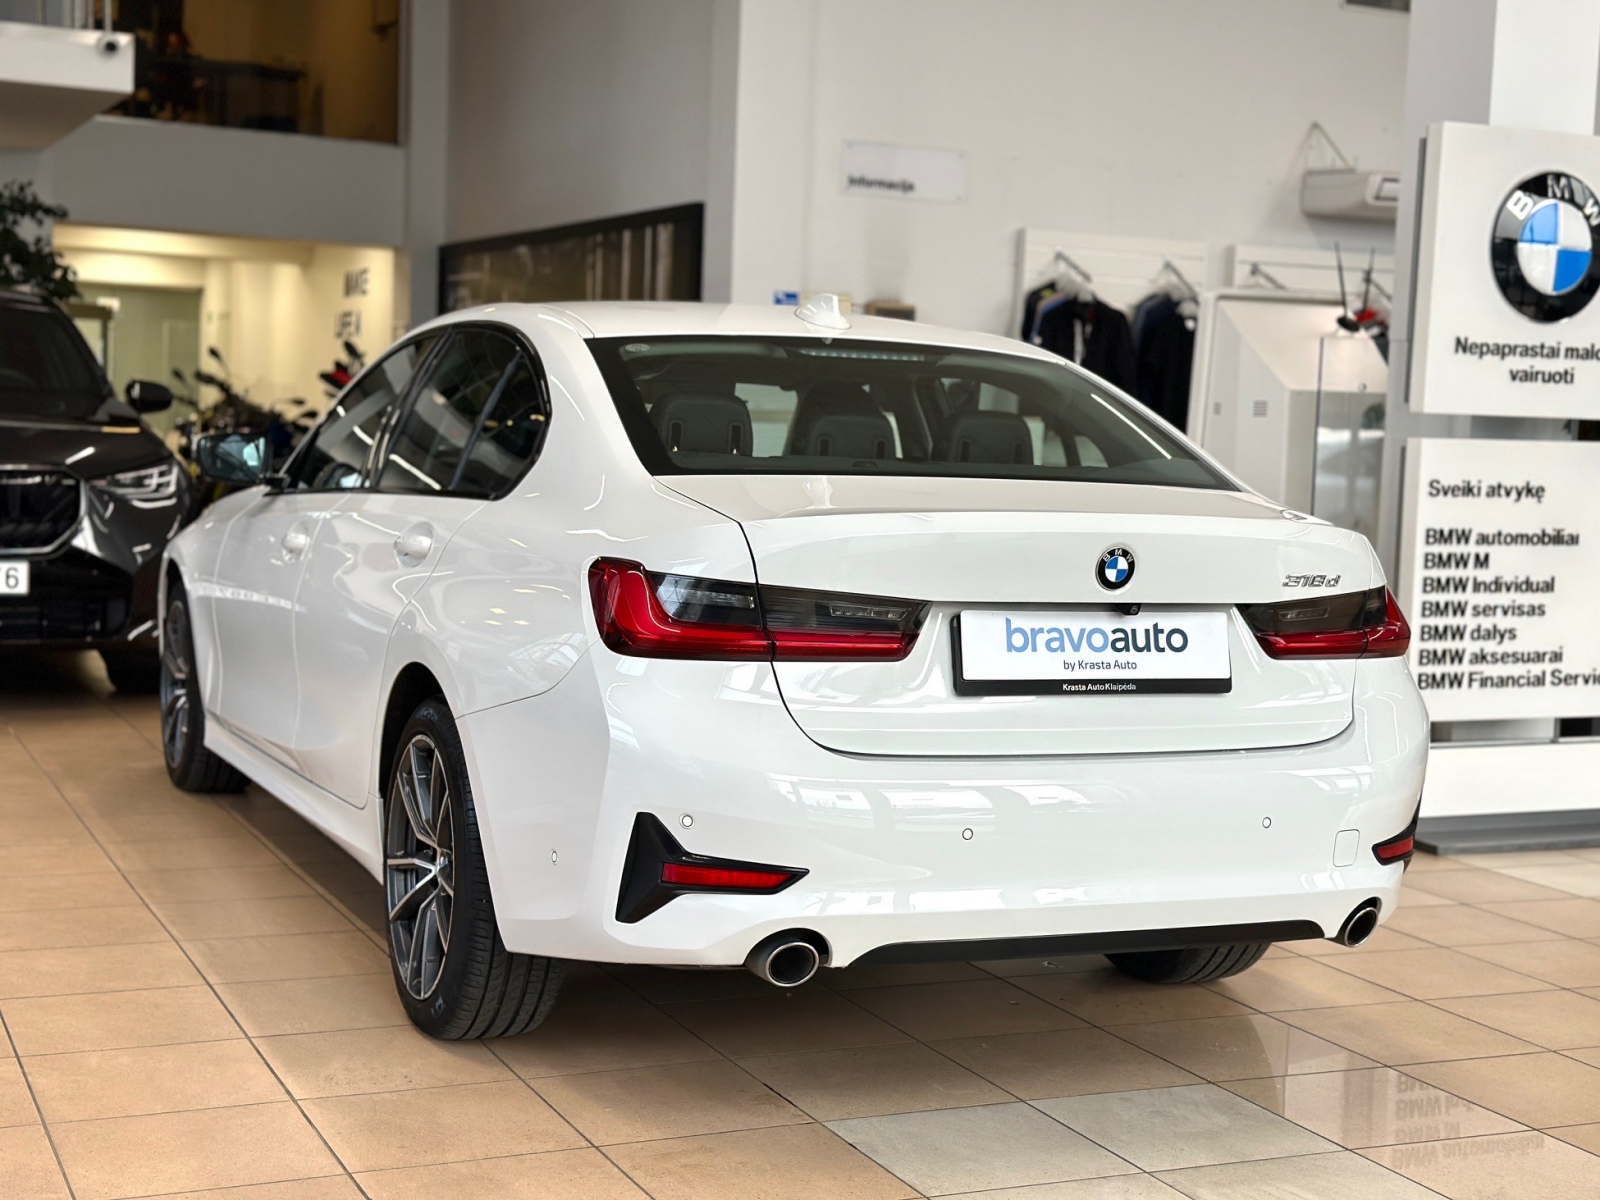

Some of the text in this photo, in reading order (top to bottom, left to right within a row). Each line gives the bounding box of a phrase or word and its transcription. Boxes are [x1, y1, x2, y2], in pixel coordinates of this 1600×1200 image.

[1454, 336, 1561, 361] Nepaprastai
[1509, 365, 1574, 384] vairuoti
[1428, 479, 1546, 504] Sveiki atvykę
[1425, 528, 1580, 546] BMW automobiliai
[1102, 548, 1134, 563] BMW
[1424, 552, 1489, 570] BMW M
[0, 566, 19, 590] 6
[1282, 574, 1340, 588] 318d
[1422, 576, 1555, 594] BMW Individual
[1421, 600, 1546, 618] BMW servisas
[1005, 617, 1189, 653] bravoauto
[1420, 624, 1517, 645] BMW dalys
[1419, 646, 1563, 666] BMW aksesuarai
[1063, 660, 1137, 672] by Krasta Auto
[1418, 673, 1463, 690] BMW
[1468, 670, 1546, 688] Financial
